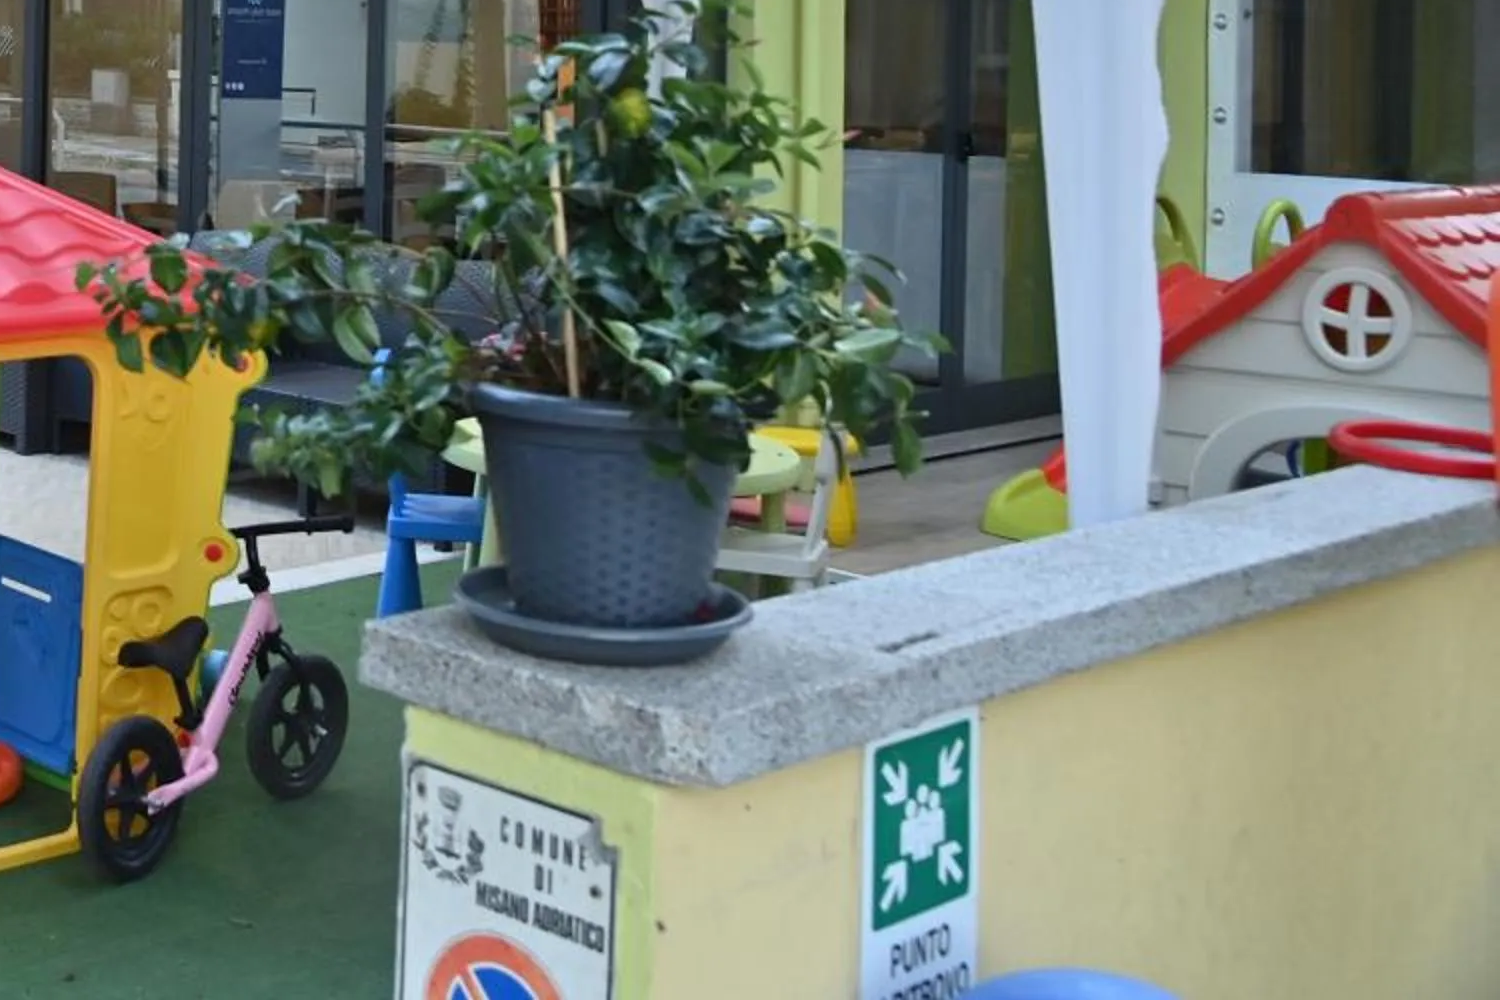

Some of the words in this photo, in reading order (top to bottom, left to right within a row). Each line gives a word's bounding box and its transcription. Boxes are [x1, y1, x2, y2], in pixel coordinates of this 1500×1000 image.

[499, 815, 587, 872] COMUNE
[534, 863, 554, 895] DI
[475, 879, 530, 925] MISANO
[532, 900, 606, 954] ADRIATICO
[889, 921, 951, 980] PUNTO
[892, 961, 971, 1000] TROVO
